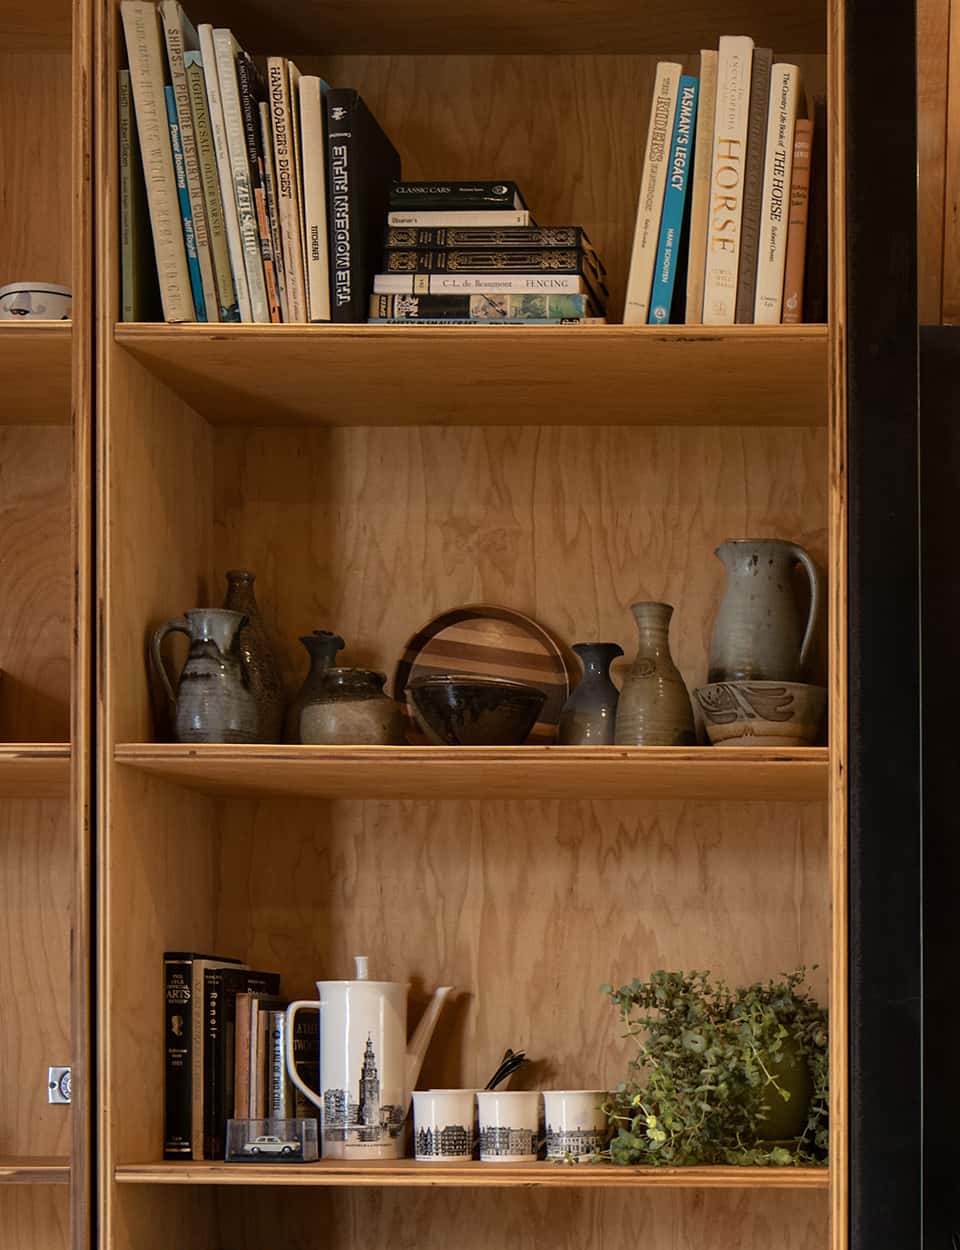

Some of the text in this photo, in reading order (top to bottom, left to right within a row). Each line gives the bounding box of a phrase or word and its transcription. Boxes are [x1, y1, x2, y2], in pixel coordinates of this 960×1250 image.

[190, 71, 205, 129] FIGHTING
[677, 86, 696, 145] TASMAN'S
[169, 123, 181, 152] Power
[269, 66, 292, 199] HANDLOADER'S DIGEST
[769, 86, 790, 222] Country THE HORSE
[174, 153, 186, 189] Boating
[175, 83, 191, 131] PICTURE
[183, 134, 199, 182] HISTORY
[193, 205, 208, 249] COLOUR
[203, 163, 215, 196] OLIVER
[671, 146, 686, 193] LEGACY
[208, 198, 222, 238] WARNER
[710, 136, 741, 255] HORSE
[331, 145, 350, 306] THE MODERN RIFLE
[525, 279, 569, 288] FENCING
[209, 992, 218, 1040] Renoir
